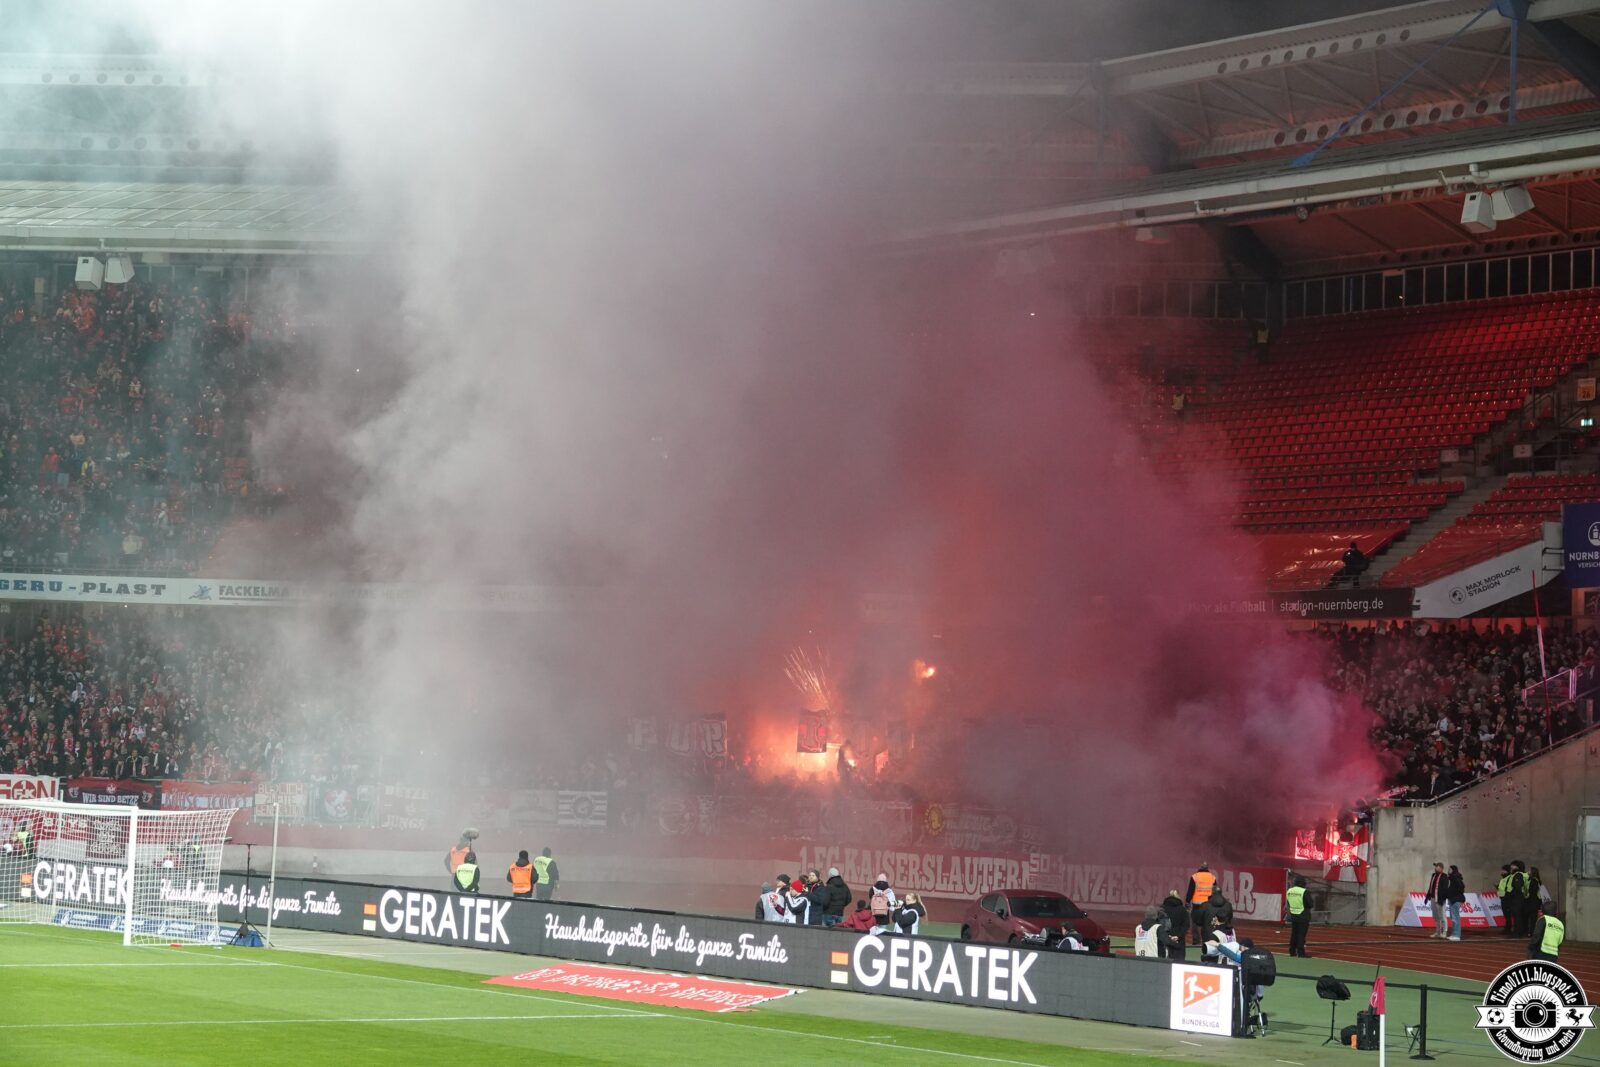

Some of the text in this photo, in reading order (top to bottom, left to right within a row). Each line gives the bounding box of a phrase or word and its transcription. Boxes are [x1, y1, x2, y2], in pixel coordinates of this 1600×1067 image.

[1465, 565, 1521, 591] MAX MORLOCK
[1467, 580, 1501, 597] STADION
[219, 585, 308, 598] FACKELMA
[1280, 597, 1384, 613] stadion-nuernberg.de
[82, 792, 139, 805] WIR SIND BETZE
[34, 861, 128, 905] GERATEK
[160, 878, 238, 914] Haushaltsgeräte
[274, 896, 301, 920] ganze
[302, 890, 342, 916] Familie
[1061, 863, 1255, 913] UNZERSTÖAR
[379, 889, 789, 966] GERATEK Haushaltsgeräte für die ganze Familie
[853, 934, 1038, 1005] GERATEK
[1181, 1017, 1220, 1028] BUNDESLIGA
